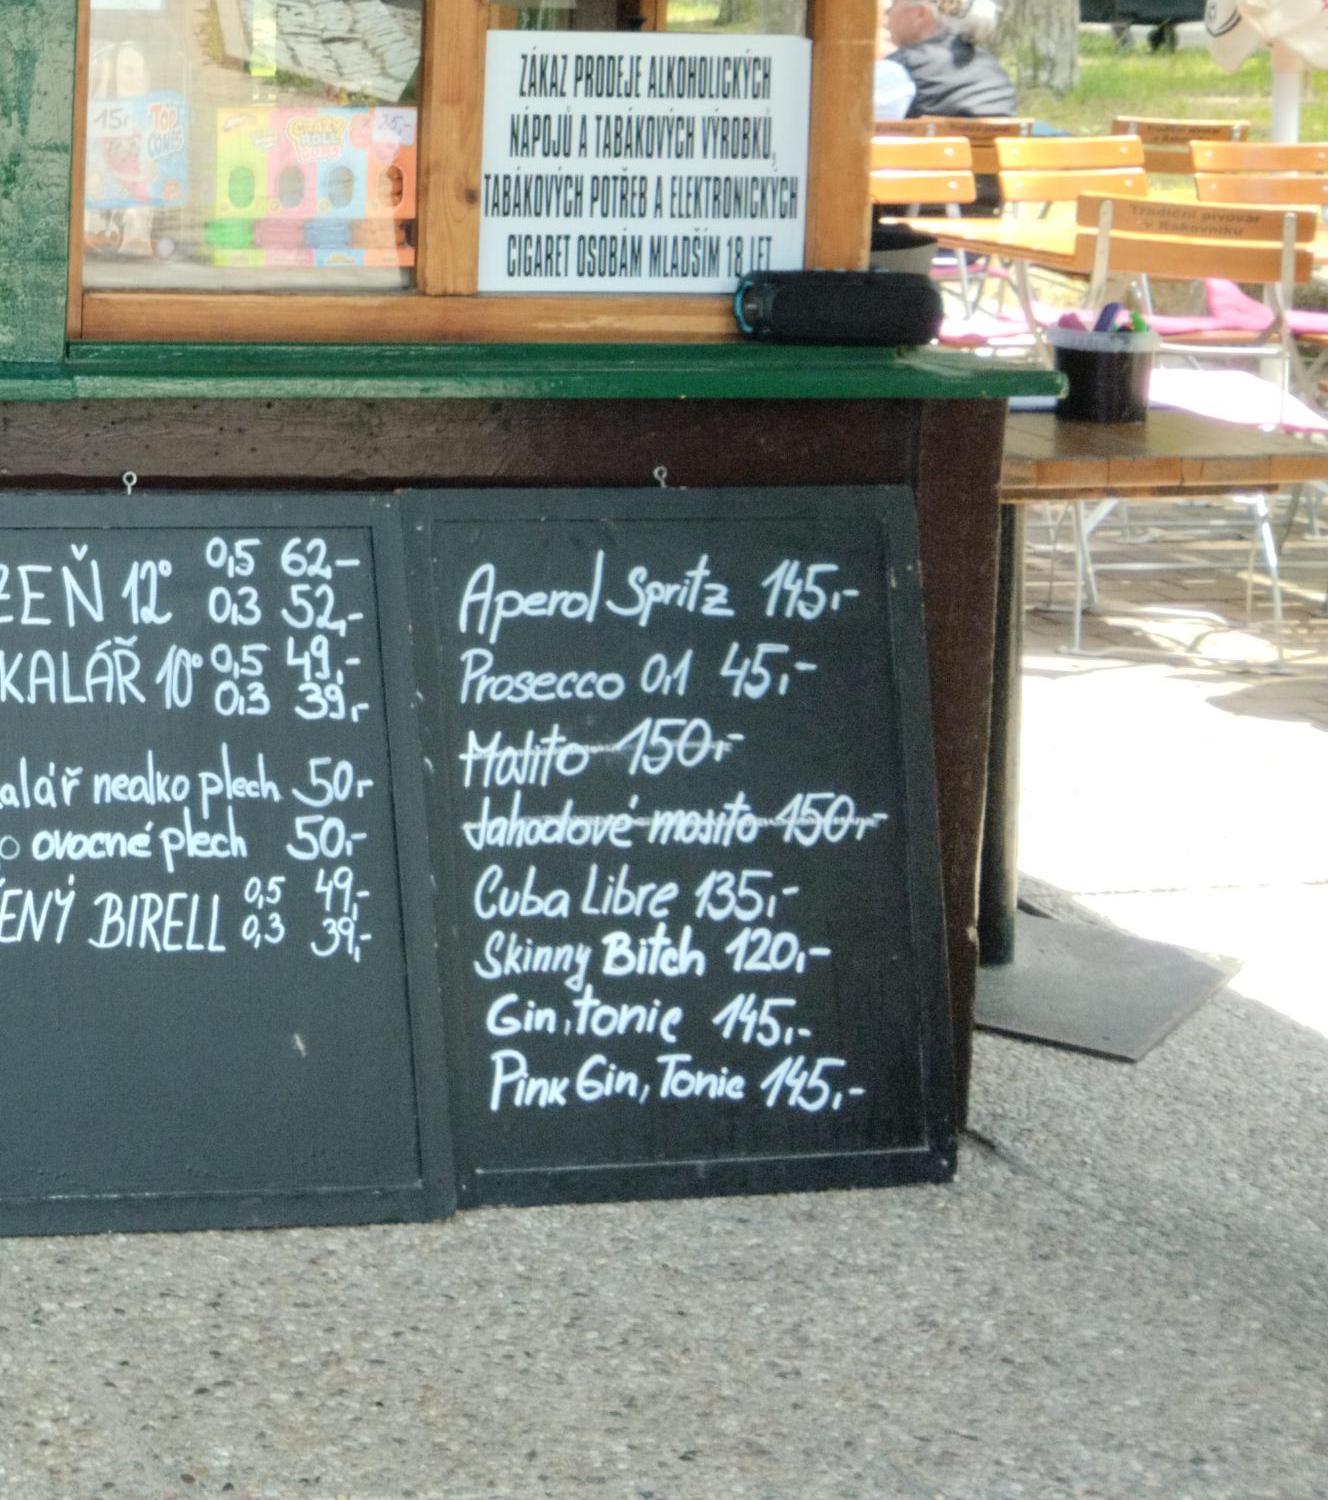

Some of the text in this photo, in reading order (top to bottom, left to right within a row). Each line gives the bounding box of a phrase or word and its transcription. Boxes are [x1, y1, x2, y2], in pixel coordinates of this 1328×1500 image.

[519, 46, 772, 100] ZÁKAZ PRODEJE ALKOHOLICKÝCH
[510, 106, 573, 158] NÁPOJŮ
[578, 115, 588, 158] A
[595, 106, 695, 160] TABÁKOVÝCH
[484, 166, 799, 220] TABÁKOVÝCH POTŘEB A ELEKTRONICKÝCH
[507, 234, 572, 278] CIGARET
[576, 228, 643, 279] OSOBÁM
[649, 227, 721, 279] MLADŠÍM
[727, 236, 742, 278] 18
[459, 549, 604, 644] Aperol
[605, 553, 734, 627] Spritz
[459, 648, 625, 703] Prosecco
[93, 750, 190, 806] nealko
[198, 743, 280, 820] plech
[32, 822, 153, 861] ovocné
[161, 806, 248, 873] plech
[474, 865, 571, 920] Cuba
[580, 864, 680, 918] Libre
[89, 893, 226, 953] BIRELL
[474, 931, 592, 990] Skinny
[602, 922, 706, 978] Bitch
